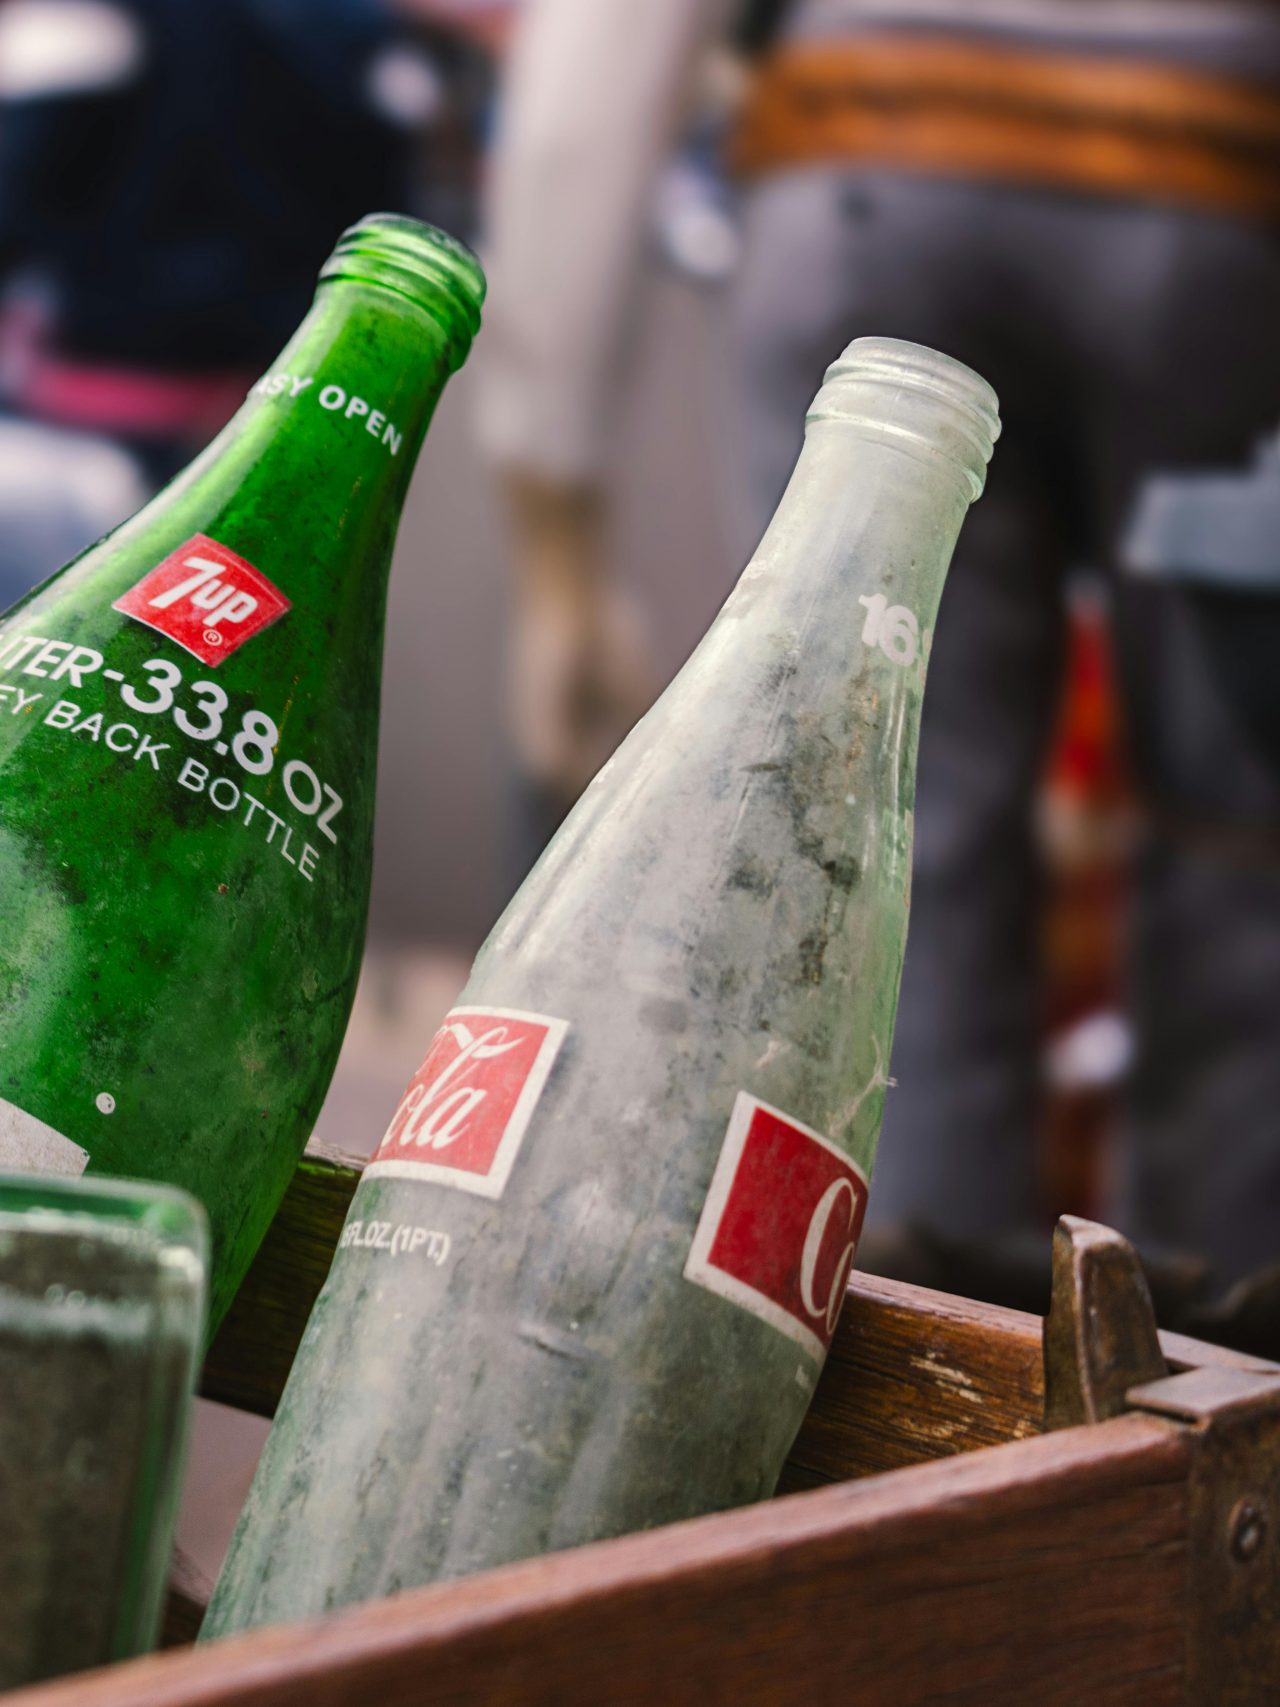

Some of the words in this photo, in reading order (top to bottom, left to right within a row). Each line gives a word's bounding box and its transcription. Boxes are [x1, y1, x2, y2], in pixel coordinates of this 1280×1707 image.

[318, 384, 403, 456] OPEN
[858, 593, 919, 667] 16
[44, 699, 171, 770] BACK
[177, 756, 320, 882] BOTTLE
